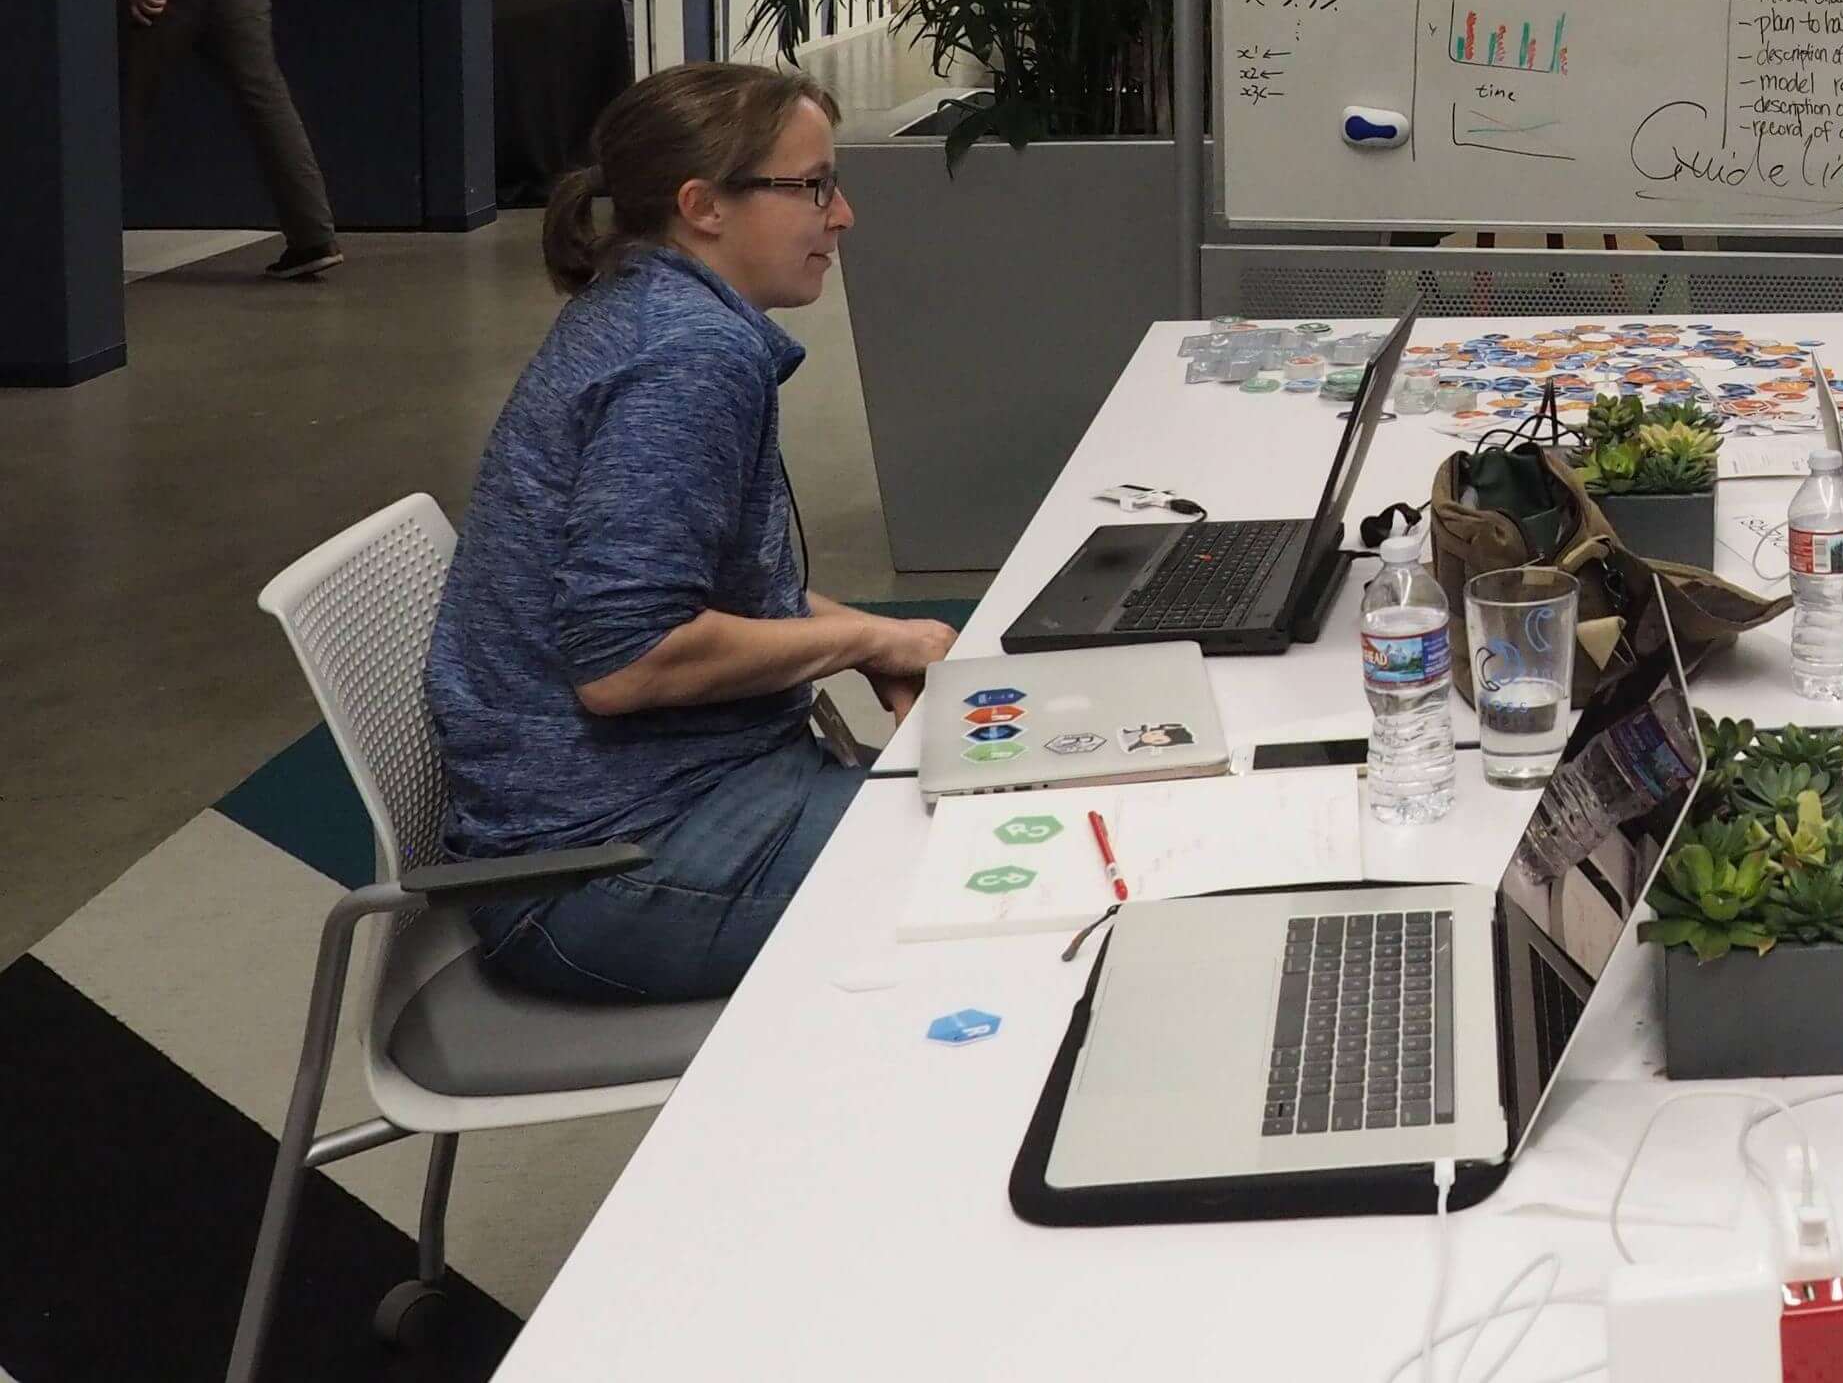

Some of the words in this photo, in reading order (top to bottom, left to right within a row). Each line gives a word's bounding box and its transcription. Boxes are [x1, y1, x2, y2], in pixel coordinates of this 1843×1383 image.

[1754, 8, 1795, 43] plan
[1800, 13, 1820, 33] to
[1756, 41, 1828, 70] description
[1475, 83, 1517, 103] time
[1760, 72, 1815, 94] model
[1753, 97, 1831, 124] description
[1752, 120, 1803, 138] record
[1814, 119, 1834, 143] of
